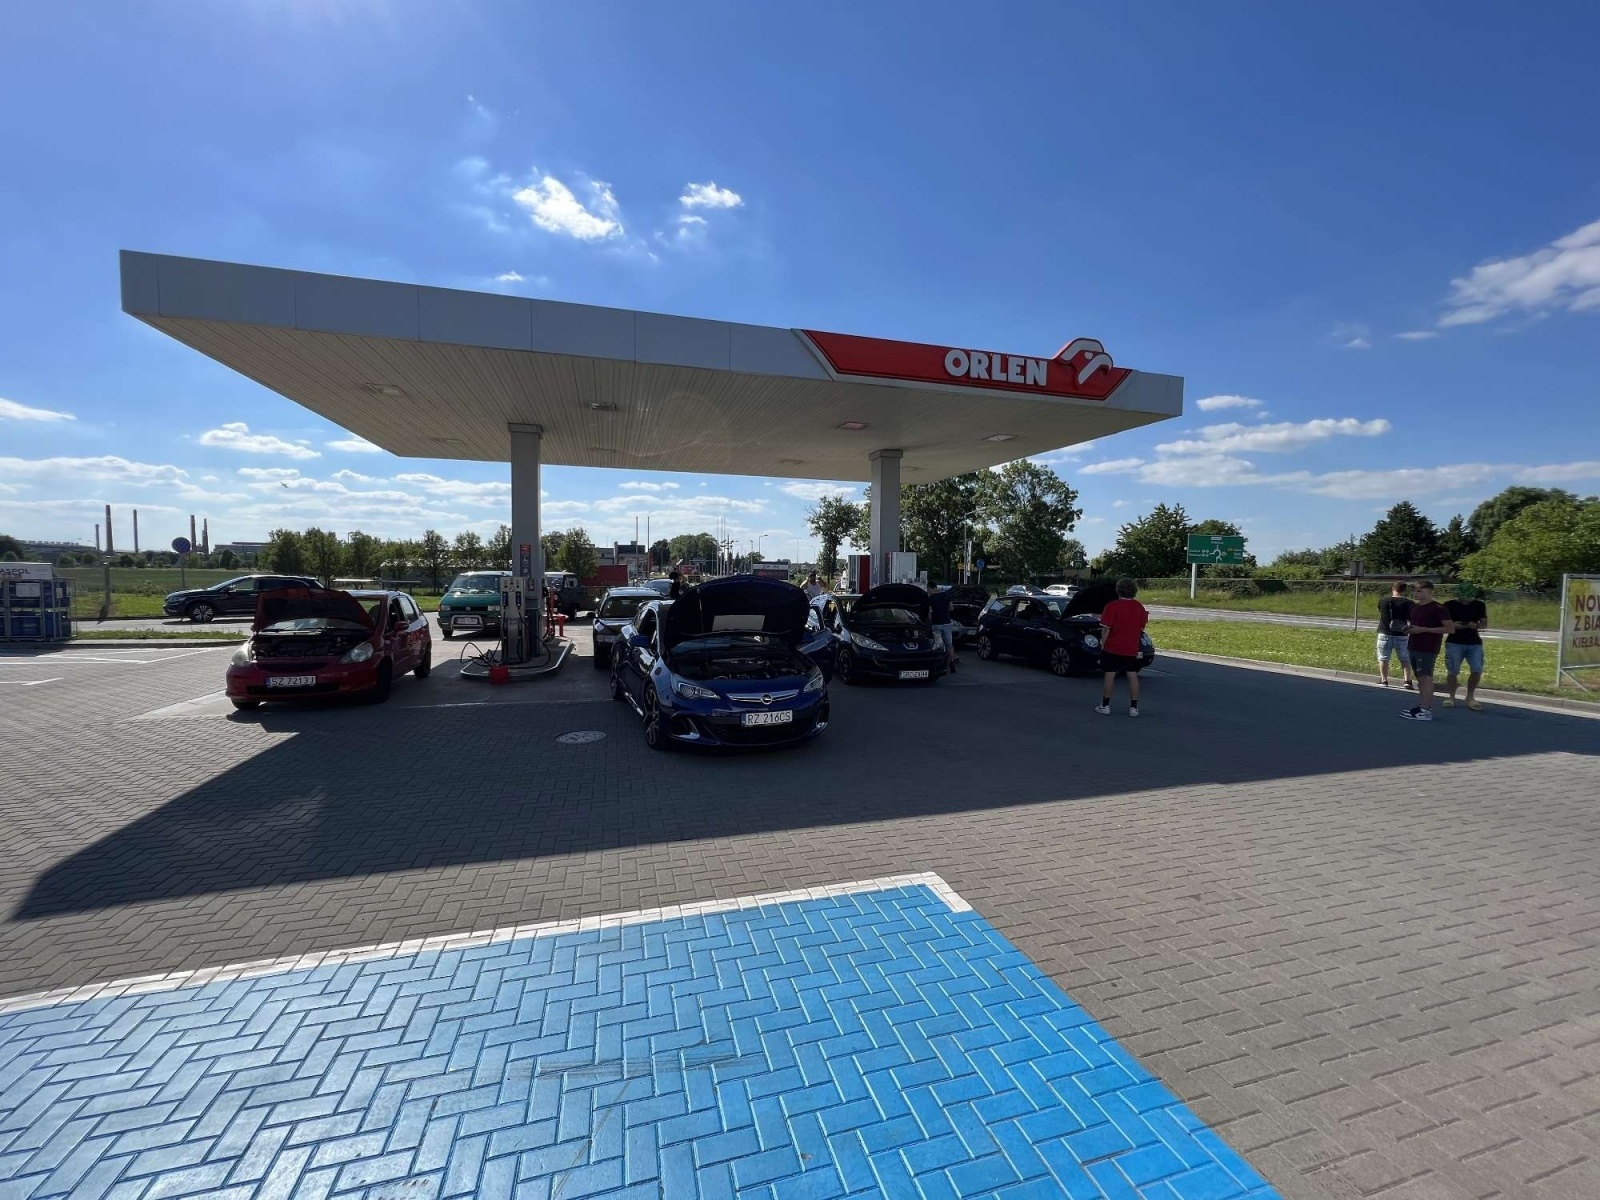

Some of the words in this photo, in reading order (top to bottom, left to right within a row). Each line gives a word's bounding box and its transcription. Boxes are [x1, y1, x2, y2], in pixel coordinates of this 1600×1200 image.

[944, 349, 1048, 386] ORLEN
[1575, 595, 1600, 612] NO
[1574, 615, 1581, 631] Z
[271, 678, 284, 686] SZ
[287, 676, 314, 685] 7213J
[747, 714, 760, 725] RZ
[763, 711, 791, 723] 216CS
